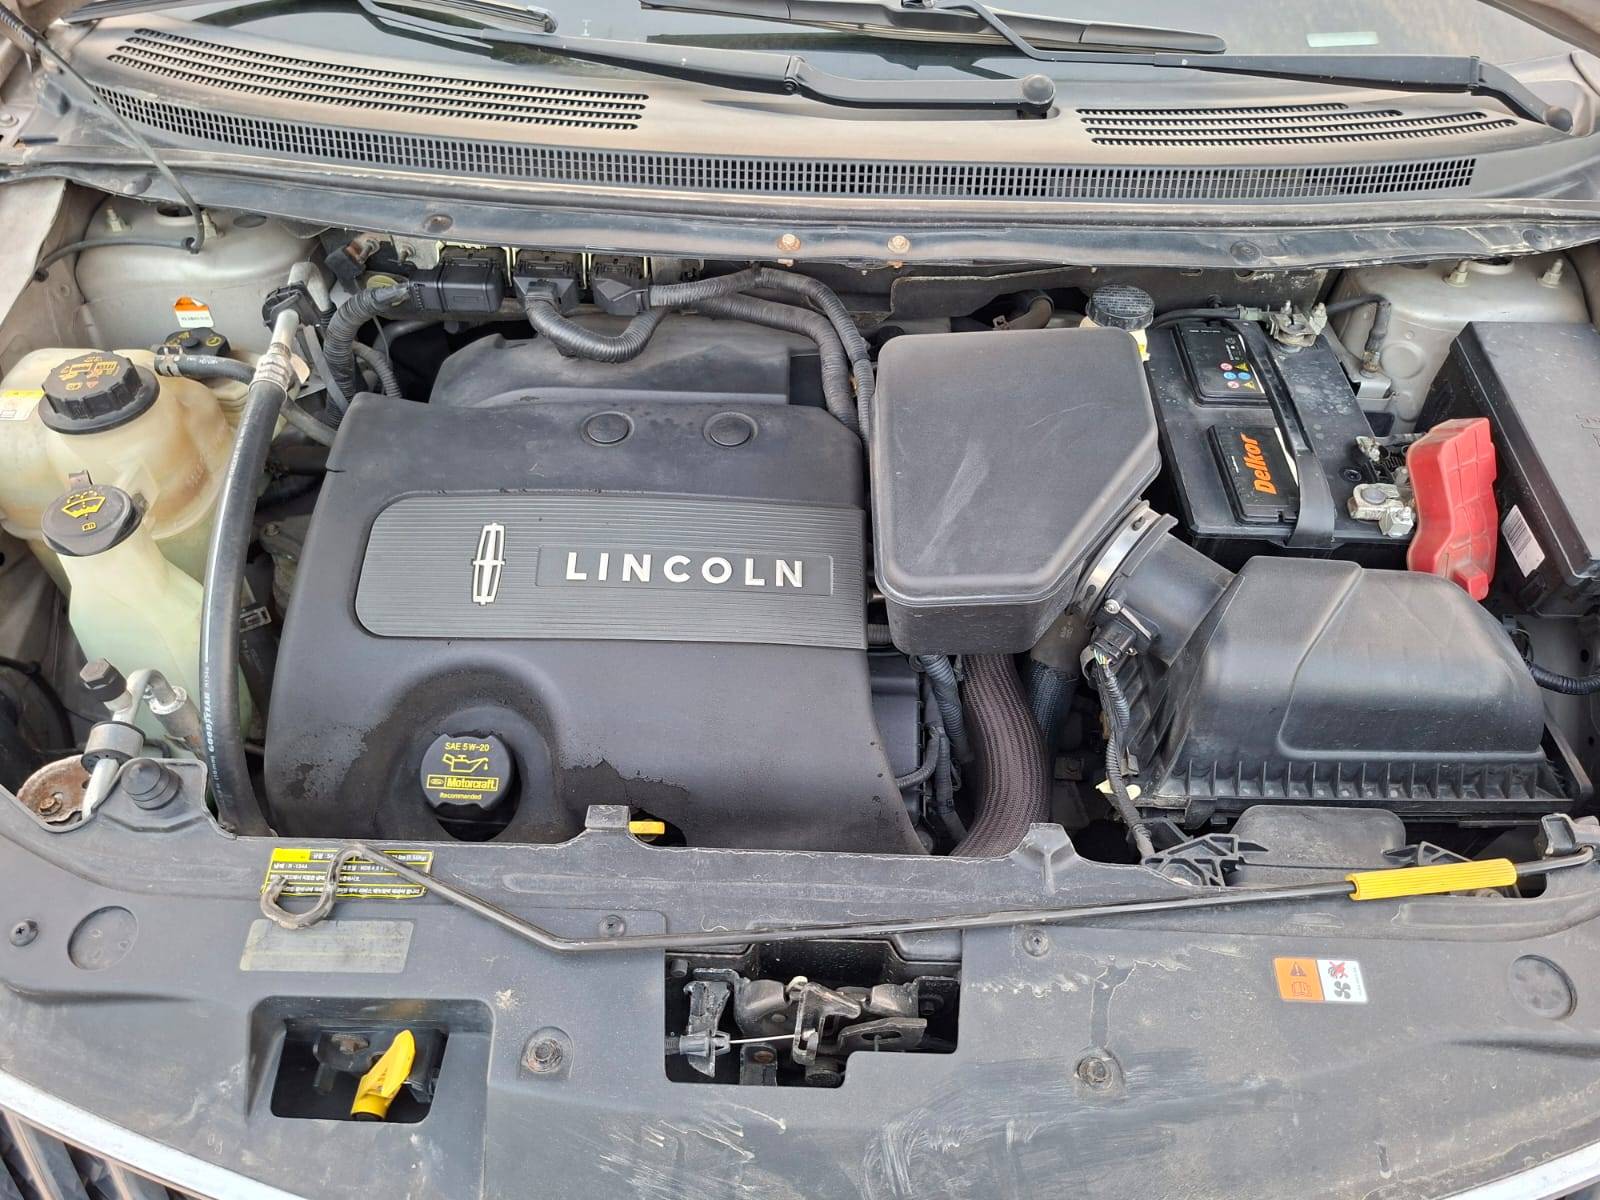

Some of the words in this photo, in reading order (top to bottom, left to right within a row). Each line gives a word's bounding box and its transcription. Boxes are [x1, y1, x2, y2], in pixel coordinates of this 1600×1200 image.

[1240, 432, 1277, 494] Delkor
[566, 551, 803, 588] LINCOLN
[203, 692, 215, 752] GOODYEAR
[445, 742, 461, 751] SAE
[462, 742, 490, 752] 5W-20
[446, 777, 495, 789] Motorcraft
[439, 792, 482, 800] Recommended
